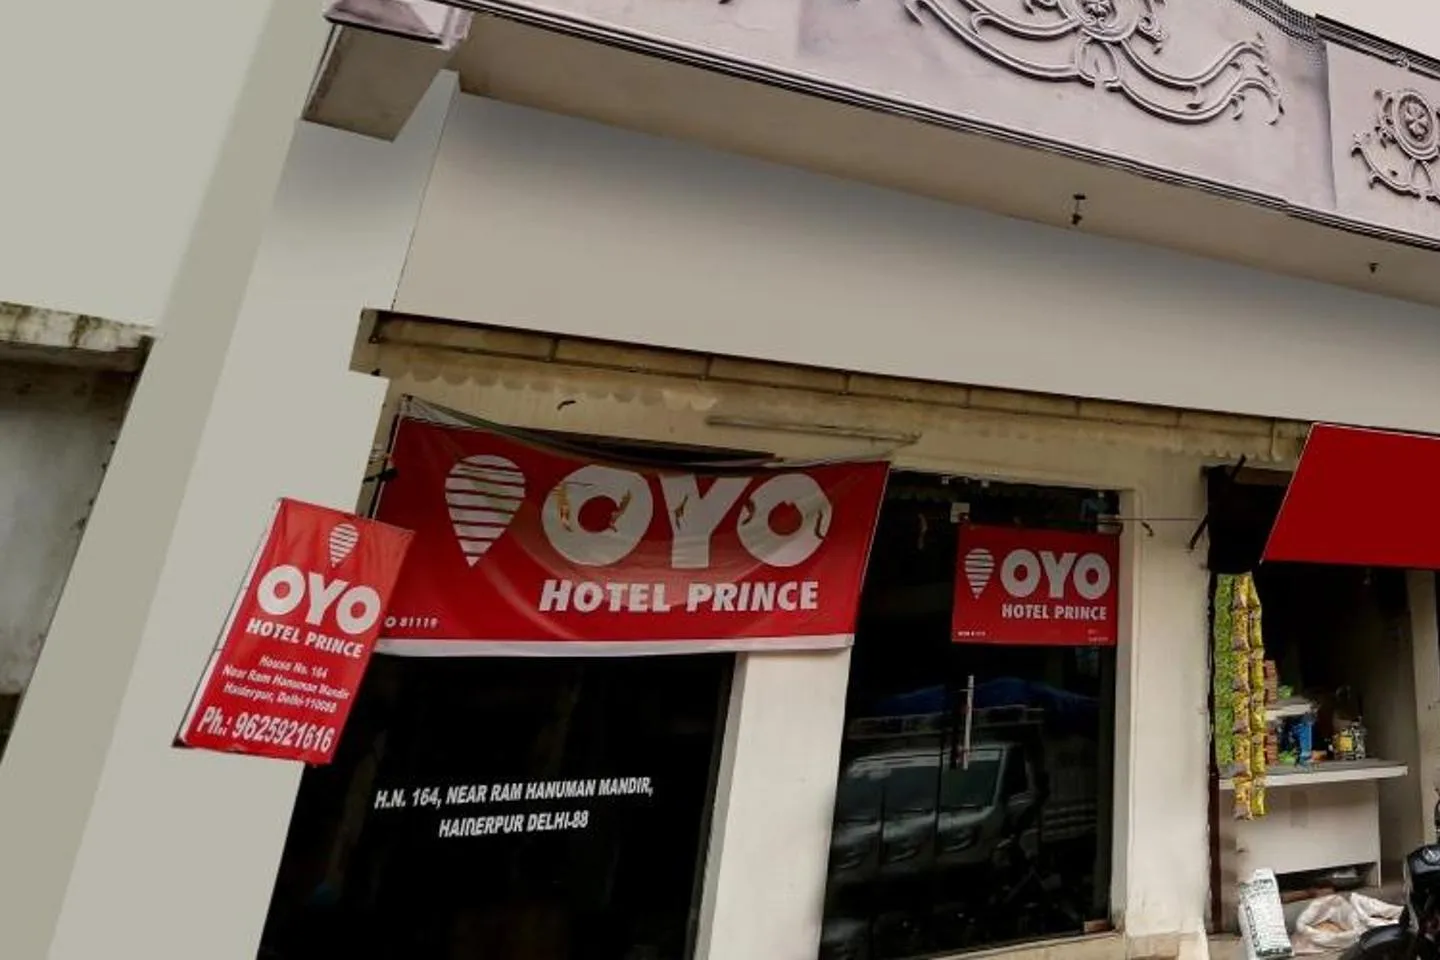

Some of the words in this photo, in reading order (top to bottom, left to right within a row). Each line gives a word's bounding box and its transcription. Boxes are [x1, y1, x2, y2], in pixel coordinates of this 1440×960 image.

[541, 464, 833, 568] OYO
[1000, 548, 1111, 600] OYO
[256, 563, 381, 635] OYO
[539, 579, 671, 612] HOTEL
[686, 581, 819, 612] PRINCE
[1002, 603, 1049, 619] HOTEL
[1054, 605, 1107, 621] PRINCE
[246, 617, 300, 644] HOTEL
[304, 631, 365, 659] PRINCE
[222, 663, 246, 680] Near
[246, 669, 272, 684] Ram
[272, 674, 318, 693] Hanuman
[318, 683, 351, 700] Mandir
[258, 655, 292, 672] House
[231, 711, 336, 754] 9625921616
[374, 789, 406, 809] H.N.
[412, 787, 442, 810] 164,
[445, 784, 488, 805] NEAR
[490, 782, 523, 801] RAM
[525, 779, 596, 800] HANUMAN
[598, 776, 654, 797] MANDIR,
